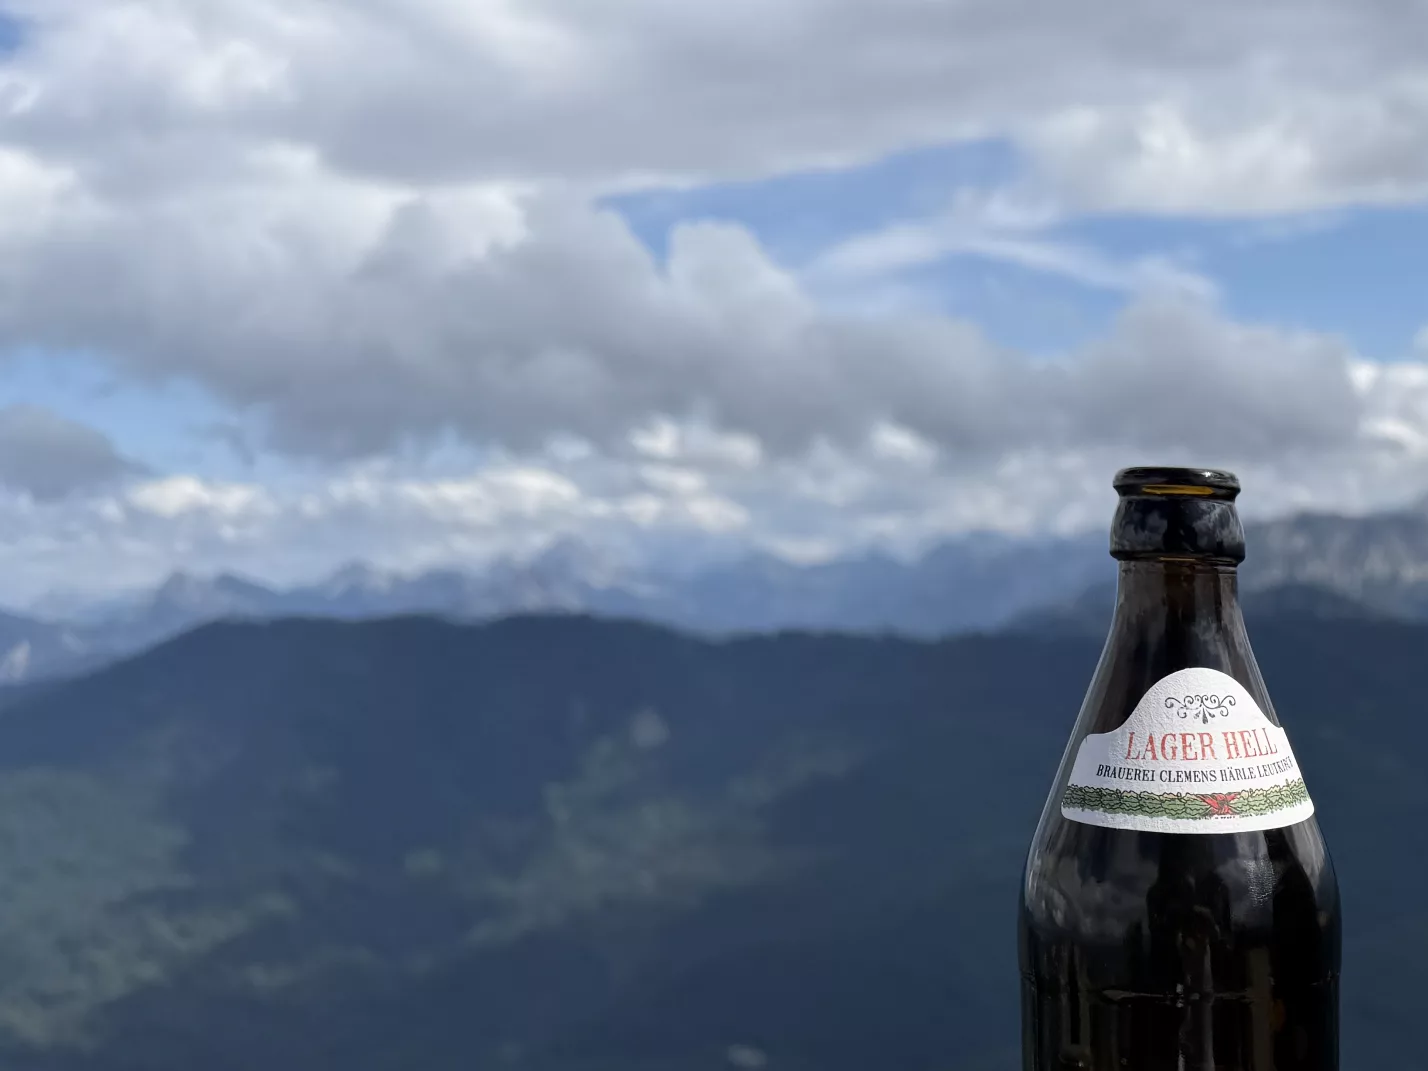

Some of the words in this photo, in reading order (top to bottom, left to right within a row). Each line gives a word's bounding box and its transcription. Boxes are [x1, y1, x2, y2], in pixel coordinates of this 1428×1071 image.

[1125, 731, 1216, 760] LAGER
[1223, 728, 1278, 760] HELL
[1096, 764, 1156, 782] BRAUEREI
[1160, 766, 1217, 783] CLEMENS
[1220, 765, 1257, 782] HÄRLE
